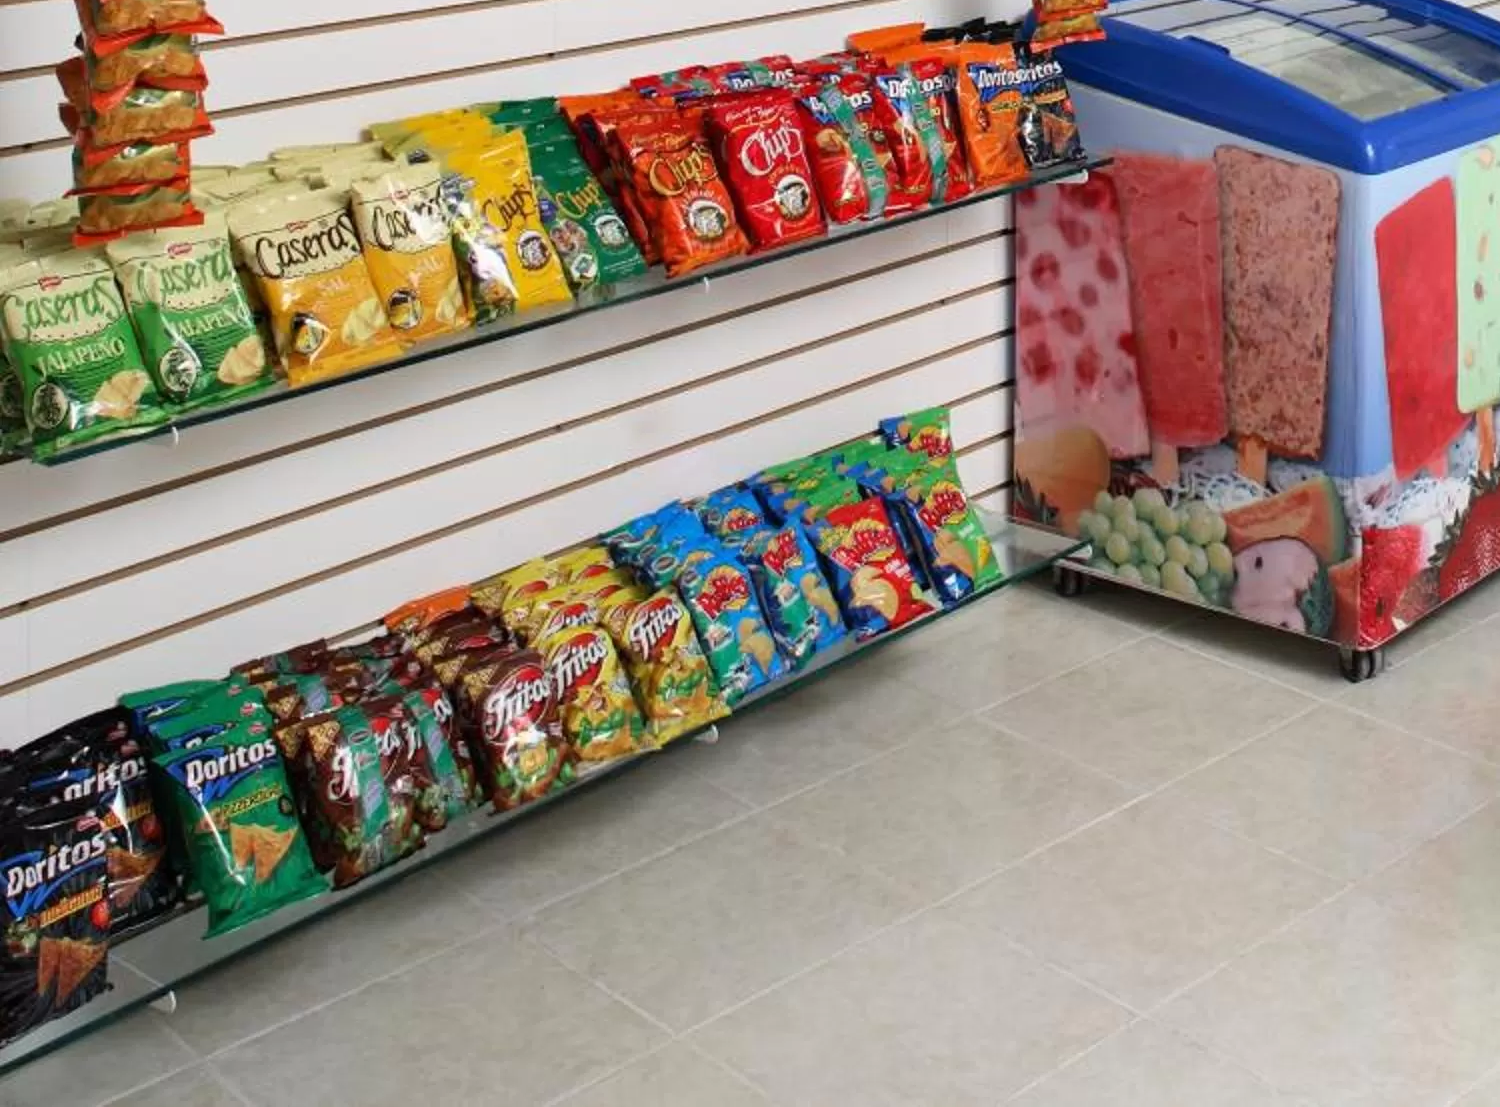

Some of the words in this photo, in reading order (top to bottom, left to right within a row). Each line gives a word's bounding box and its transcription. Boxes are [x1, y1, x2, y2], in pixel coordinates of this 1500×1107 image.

[255, 210, 362, 280] Caseras
[630, 602, 683, 661] Fritos
[551, 636, 608, 701] Fritos
[485, 669, 550, 741] Fritos
[186, 738, 276, 790] Doritos
[7, 832, 108, 898] Doritos
